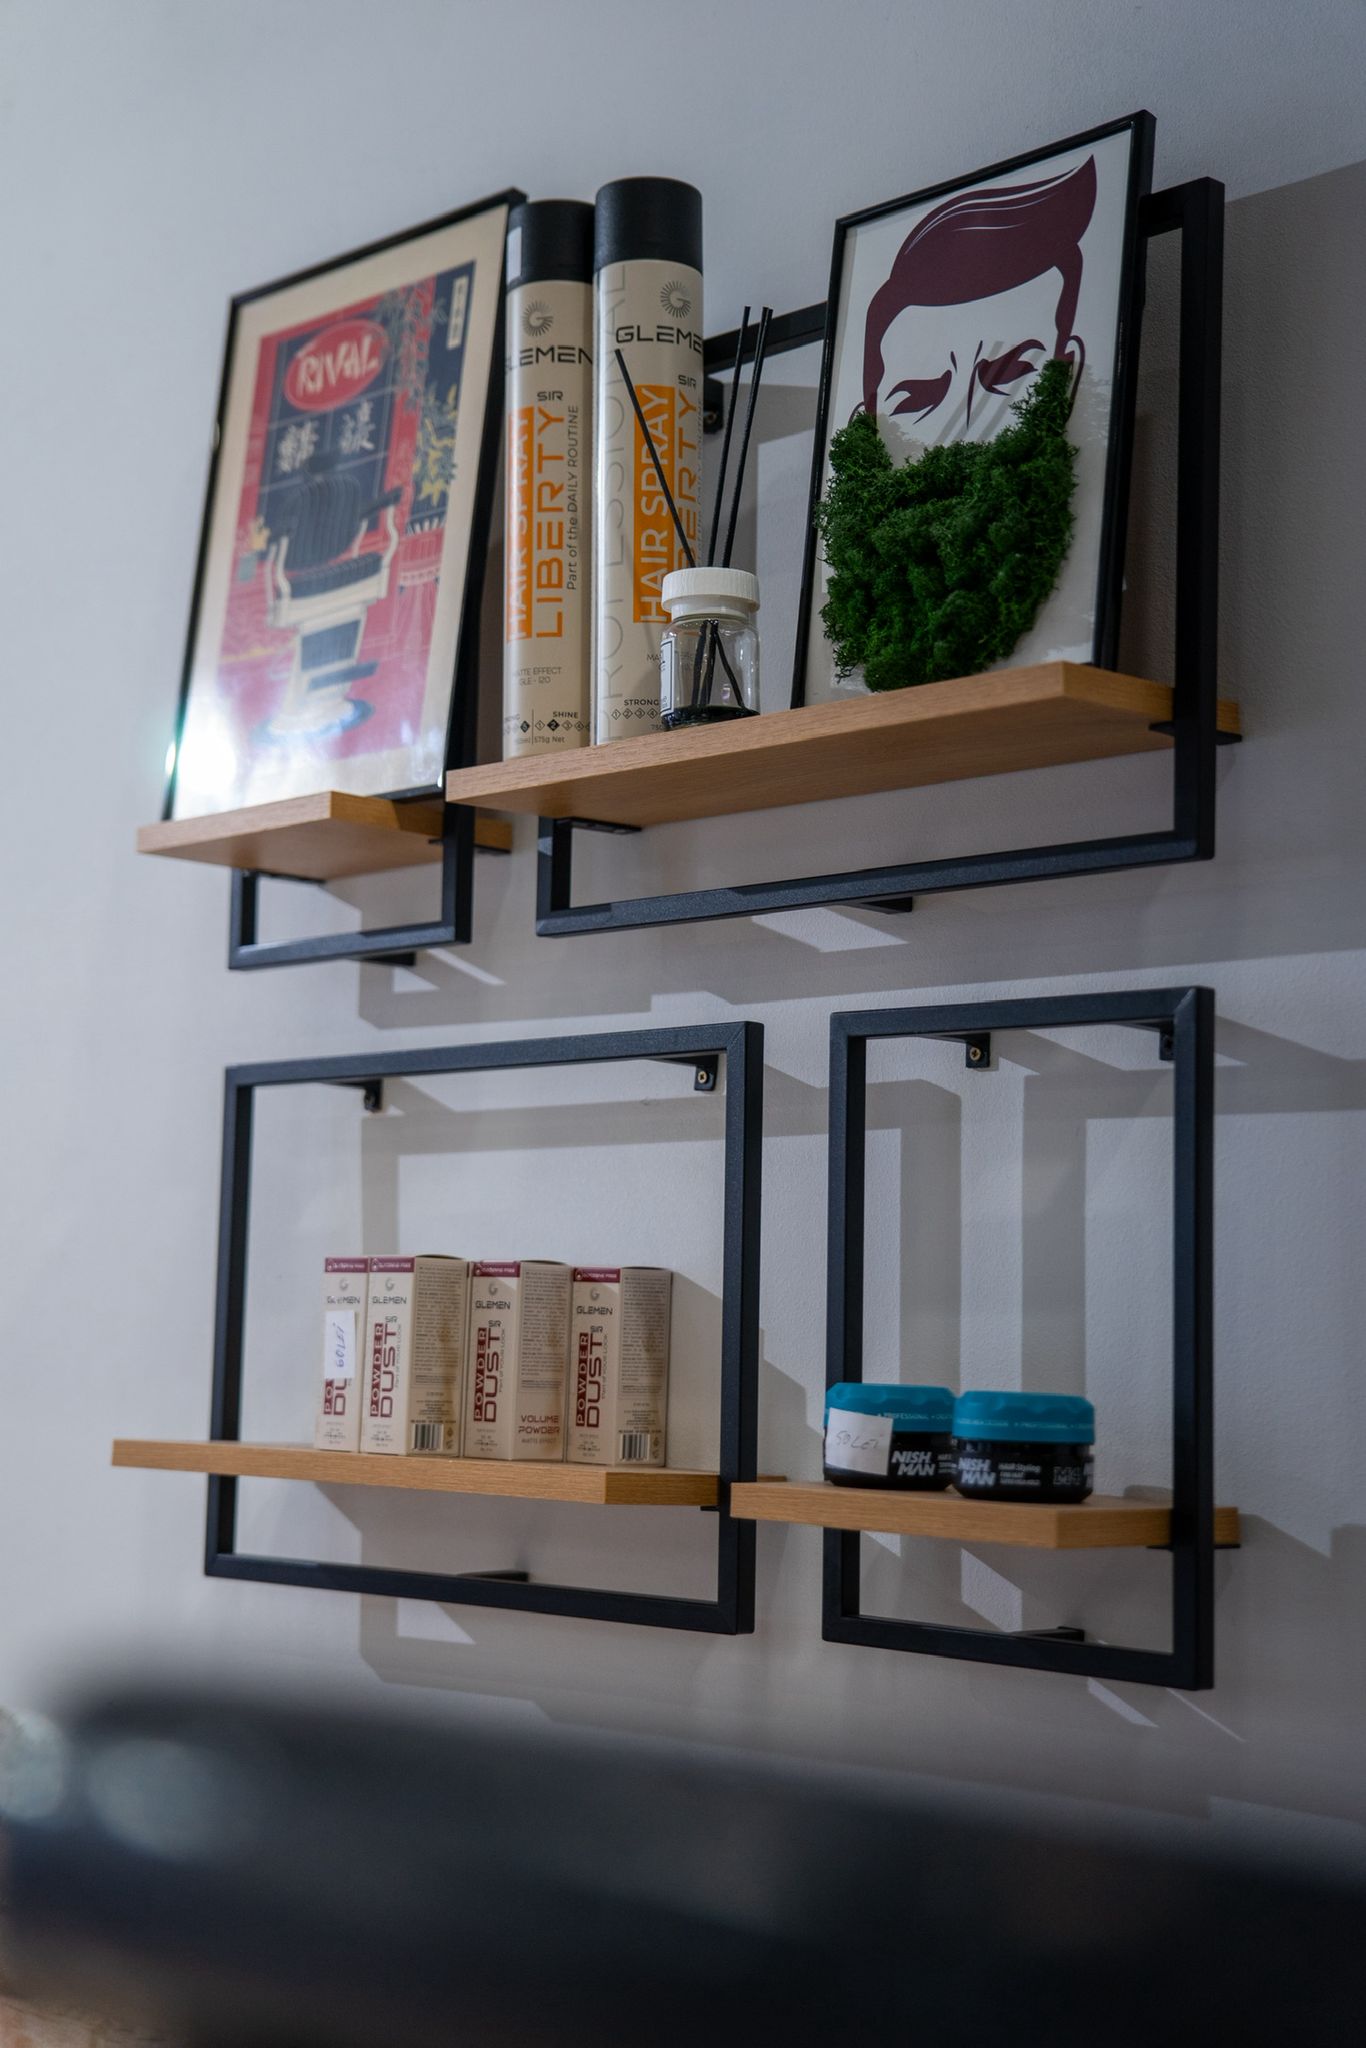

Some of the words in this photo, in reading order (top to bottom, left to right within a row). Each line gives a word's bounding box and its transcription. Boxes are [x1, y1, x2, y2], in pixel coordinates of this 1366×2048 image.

[615, 325, 703, 354] GLEME
[296, 334, 380, 396] RIVAL
[678, 374, 697, 389] SIR
[536, 390, 564, 402] SIR
[566, 404, 579, 468] ROUTINE
[640, 384, 671, 517] SPRAY
[566, 471, 578, 513] DAILY
[536, 406, 564, 638] LIBERTY
[566, 518, 578, 540] the
[566, 543, 578, 558] of
[566, 562, 578, 590] Part
[640, 528, 668, 623] HAIR
[533, 666, 562, 675] EFFECT
[552, 711, 579, 719] SHINE
[552, 735, 566, 744] Net
[371, 1295, 407, 1304] GLEMEN
[475, 1300, 511, 1310] GLEMEN
[576, 1305, 613, 1316] GLEMEN
[488, 1320, 502, 1328] SIR
[590, 1325, 603, 1333] SIR
[371, 1324, 383, 1416] POWDER
[380, 1323, 397, 1418] DUST
[474, 1328, 487, 1421] POWDER
[484, 1328, 499, 1423] DUST
[576, 1334, 588, 1427] POWDER
[587, 1333, 603, 1428] DUST
[521, 1414, 559, 1424] VOLUME
[518, 1425, 560, 1435] POWDER
[891, 1450, 932, 1464] NISH
[958, 1456, 992, 1471] NISH
[897, 1463, 936, 1476] MAN
[961, 1471, 996, 1486] MAN
